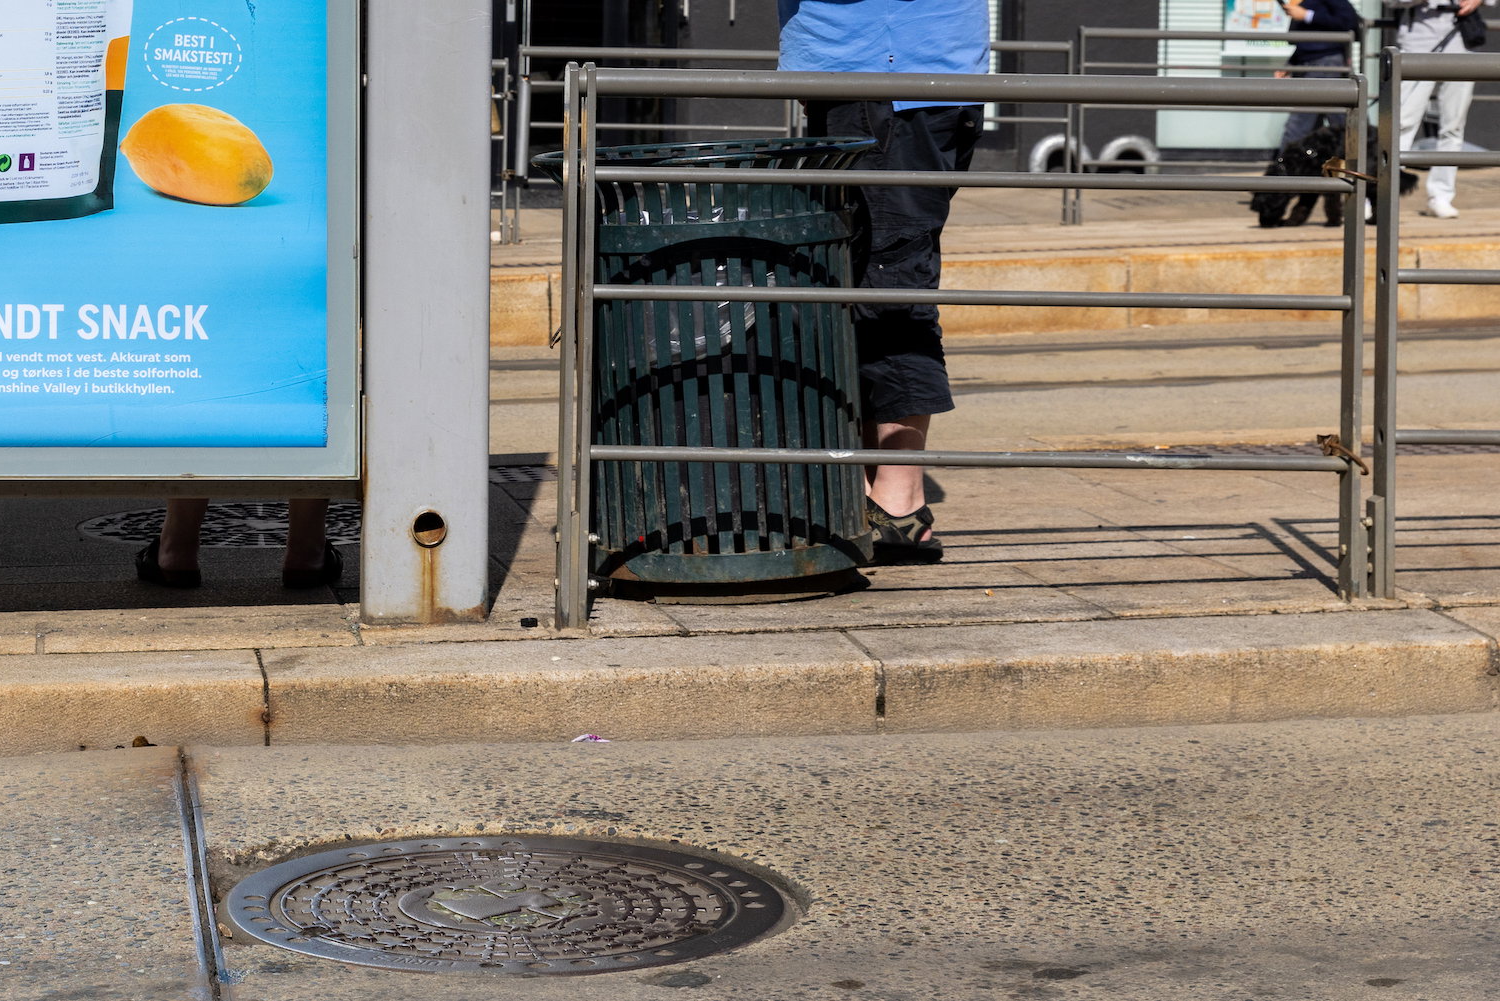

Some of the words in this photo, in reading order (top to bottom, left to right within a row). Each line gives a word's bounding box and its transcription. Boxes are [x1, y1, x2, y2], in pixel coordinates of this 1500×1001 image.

[174, 34, 207, 48] BEST
[209, 36, 215, 49] I
[153, 48, 233, 65] SMAKSTEST!
[76, 304, 209, 341] SNACK
[5, 351, 44, 363] vendt
[46, 352, 74, 363] mot
[76, 352, 107, 363] vest.
[110, 352, 161, 363] Akkurat
[164, 354, 192, 363] som
[2, 369, 19, 380] og
[23, 368, 64, 379] tørkes
[66, 367, 71, 378] i
[73, 367, 91, 378] de
[93, 367, 130, 378] beste
[132, 367, 203, 379] solforhold.
[43, 382, 82, 396] Valley
[84, 382, 89, 393] i
[91, 382, 175, 396] butikkhyllen.
